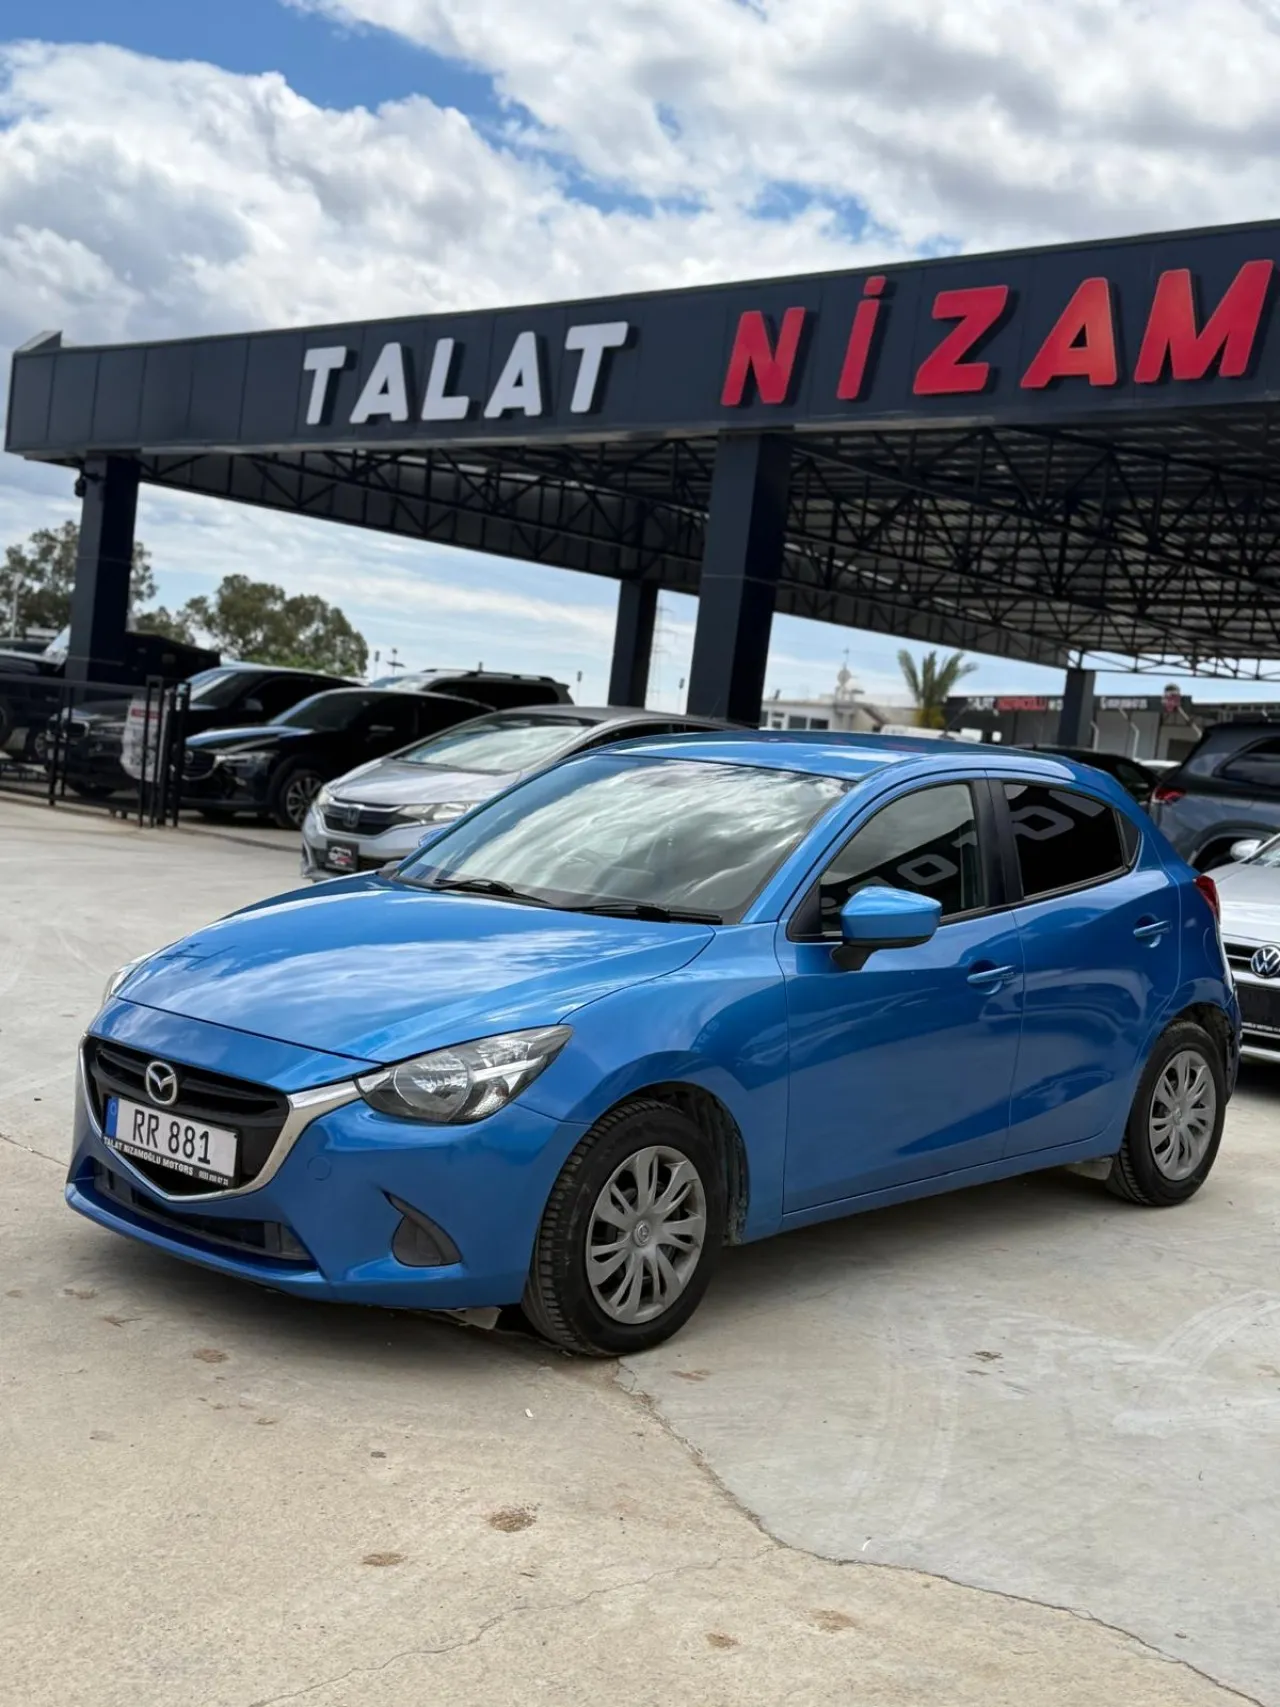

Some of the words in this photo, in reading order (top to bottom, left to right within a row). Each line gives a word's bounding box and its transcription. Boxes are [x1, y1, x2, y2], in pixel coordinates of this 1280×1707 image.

[303, 321, 628, 425] TALAT
[721, 259, 1274, 406] NİZAM
[132, 1109, 160, 1149] RR
[168, 1120, 211, 1165] 881
[162, 1158, 193, 1177] MOTORS
